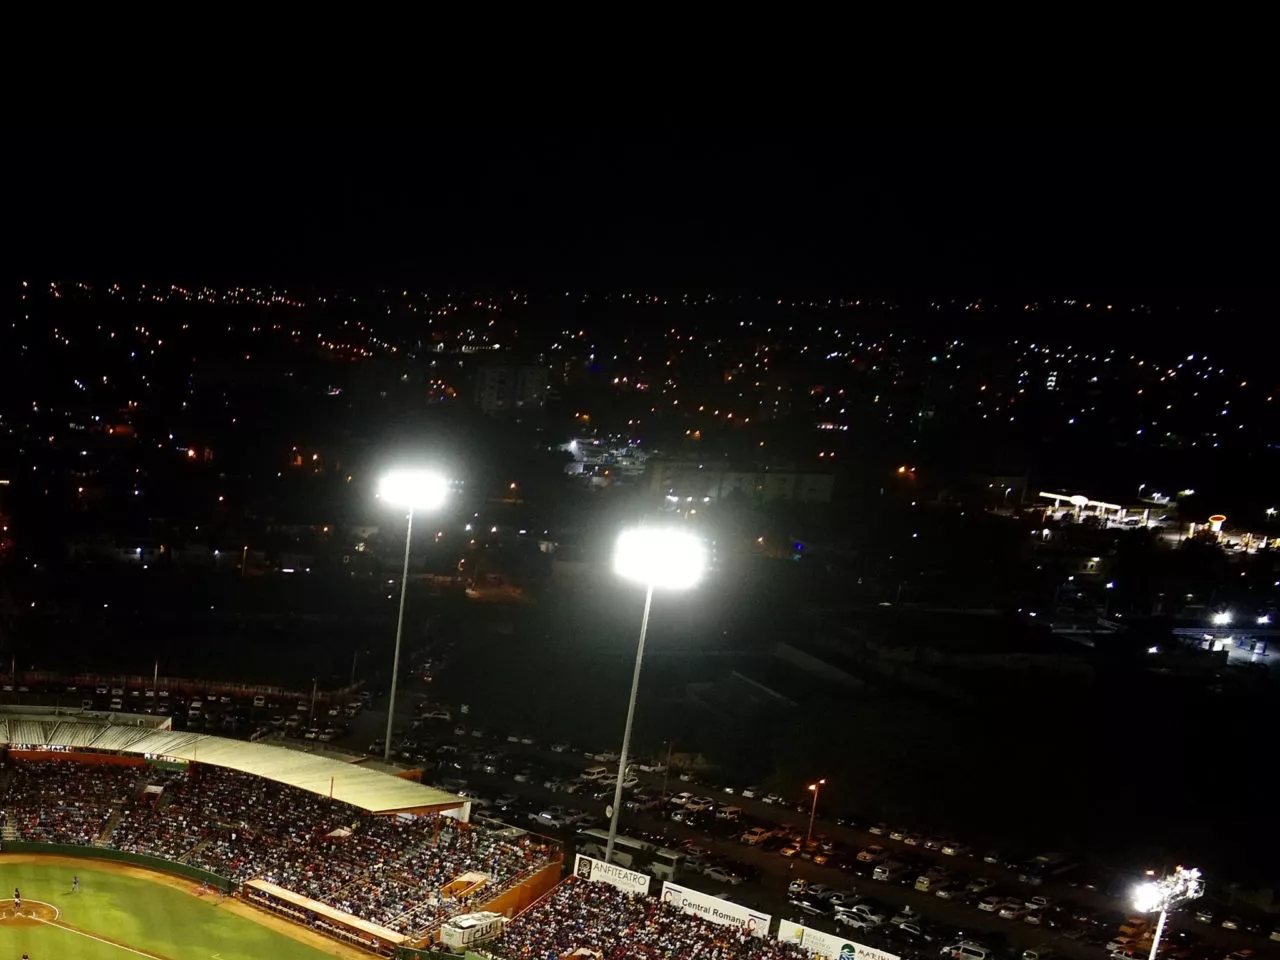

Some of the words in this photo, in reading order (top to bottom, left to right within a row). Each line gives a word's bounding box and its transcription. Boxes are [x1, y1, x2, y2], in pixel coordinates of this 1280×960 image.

[593, 862, 646, 886] ANFITEATRO
[682, 898, 710, 914] Central
[713, 909, 746, 926] Romana
